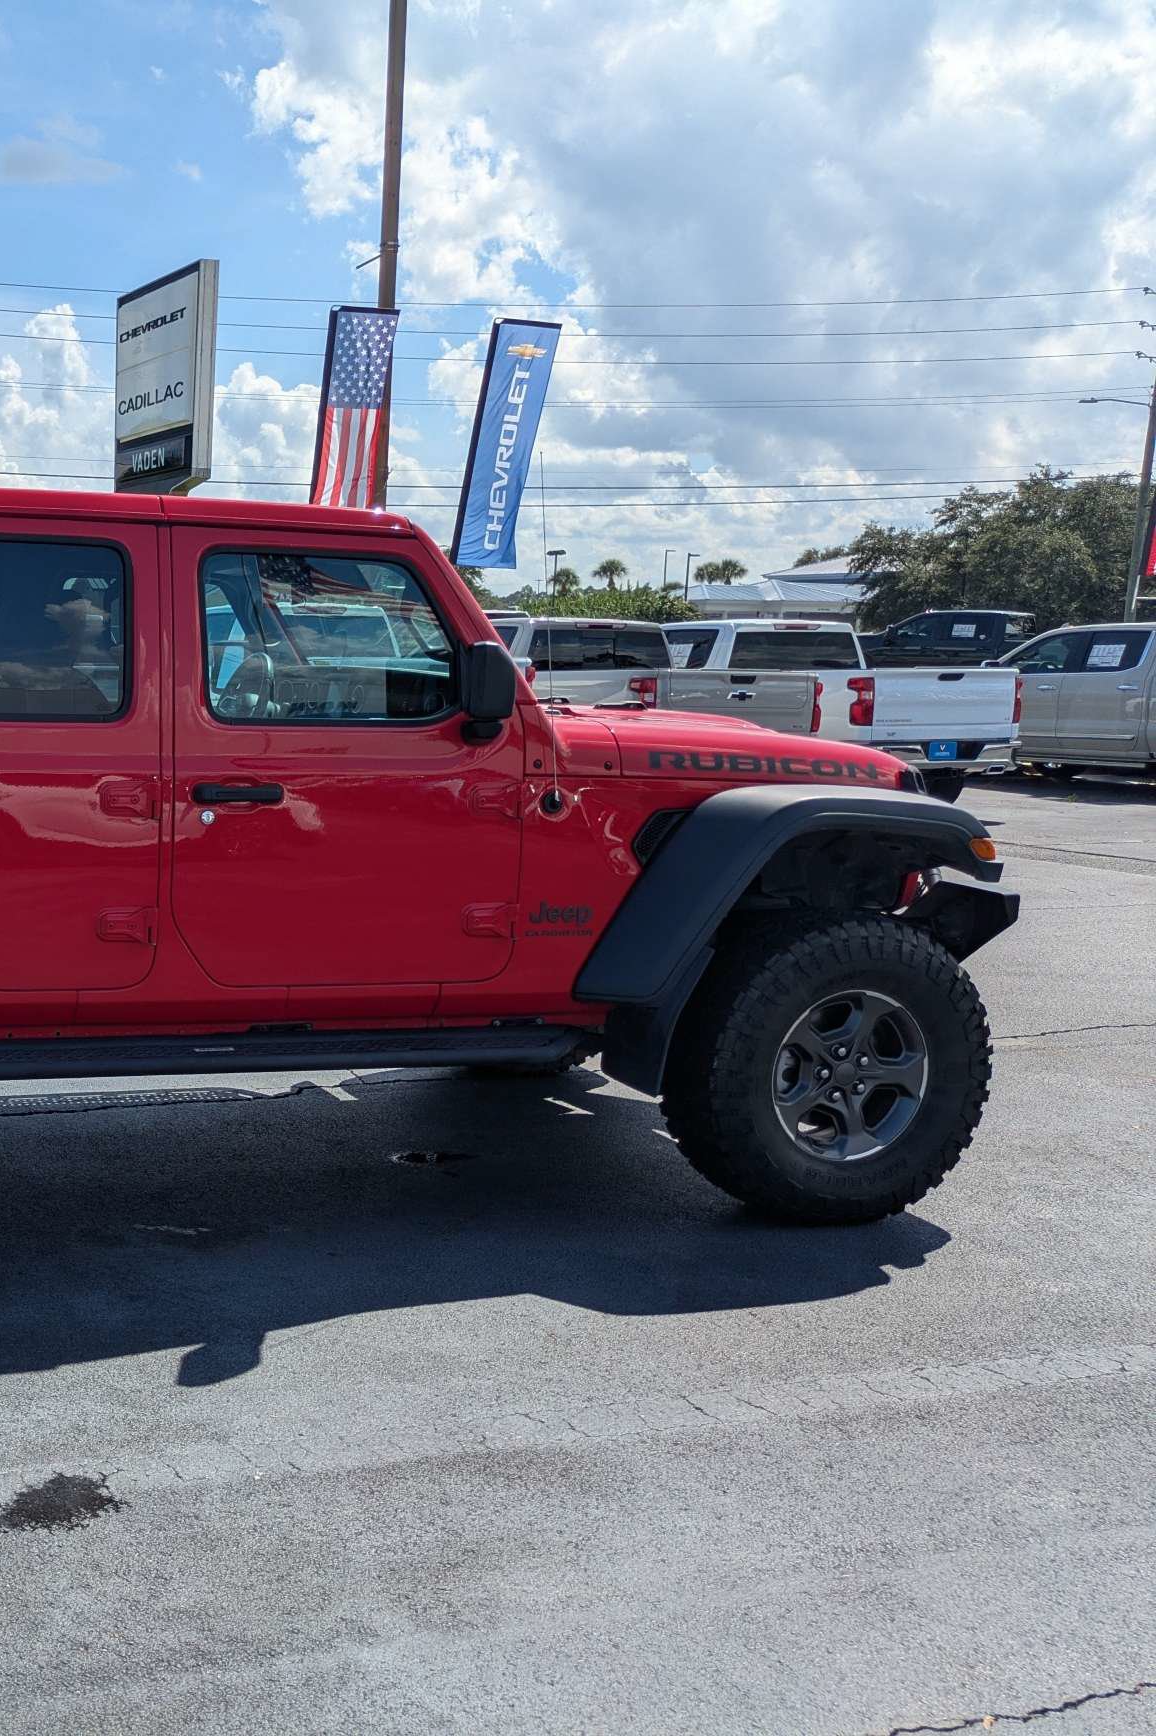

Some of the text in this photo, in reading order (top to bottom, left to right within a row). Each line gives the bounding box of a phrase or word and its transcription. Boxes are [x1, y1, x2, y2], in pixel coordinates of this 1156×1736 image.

[119, 307, 187, 344] CHEVROLET
[118, 381, 184, 416] CADILLAC
[132, 447, 165, 473] VADEN
[483, 363, 531, 551] CHEVROLET
[648, 751, 879, 780] RUBICON
[529, 900, 592, 926] Jeep
